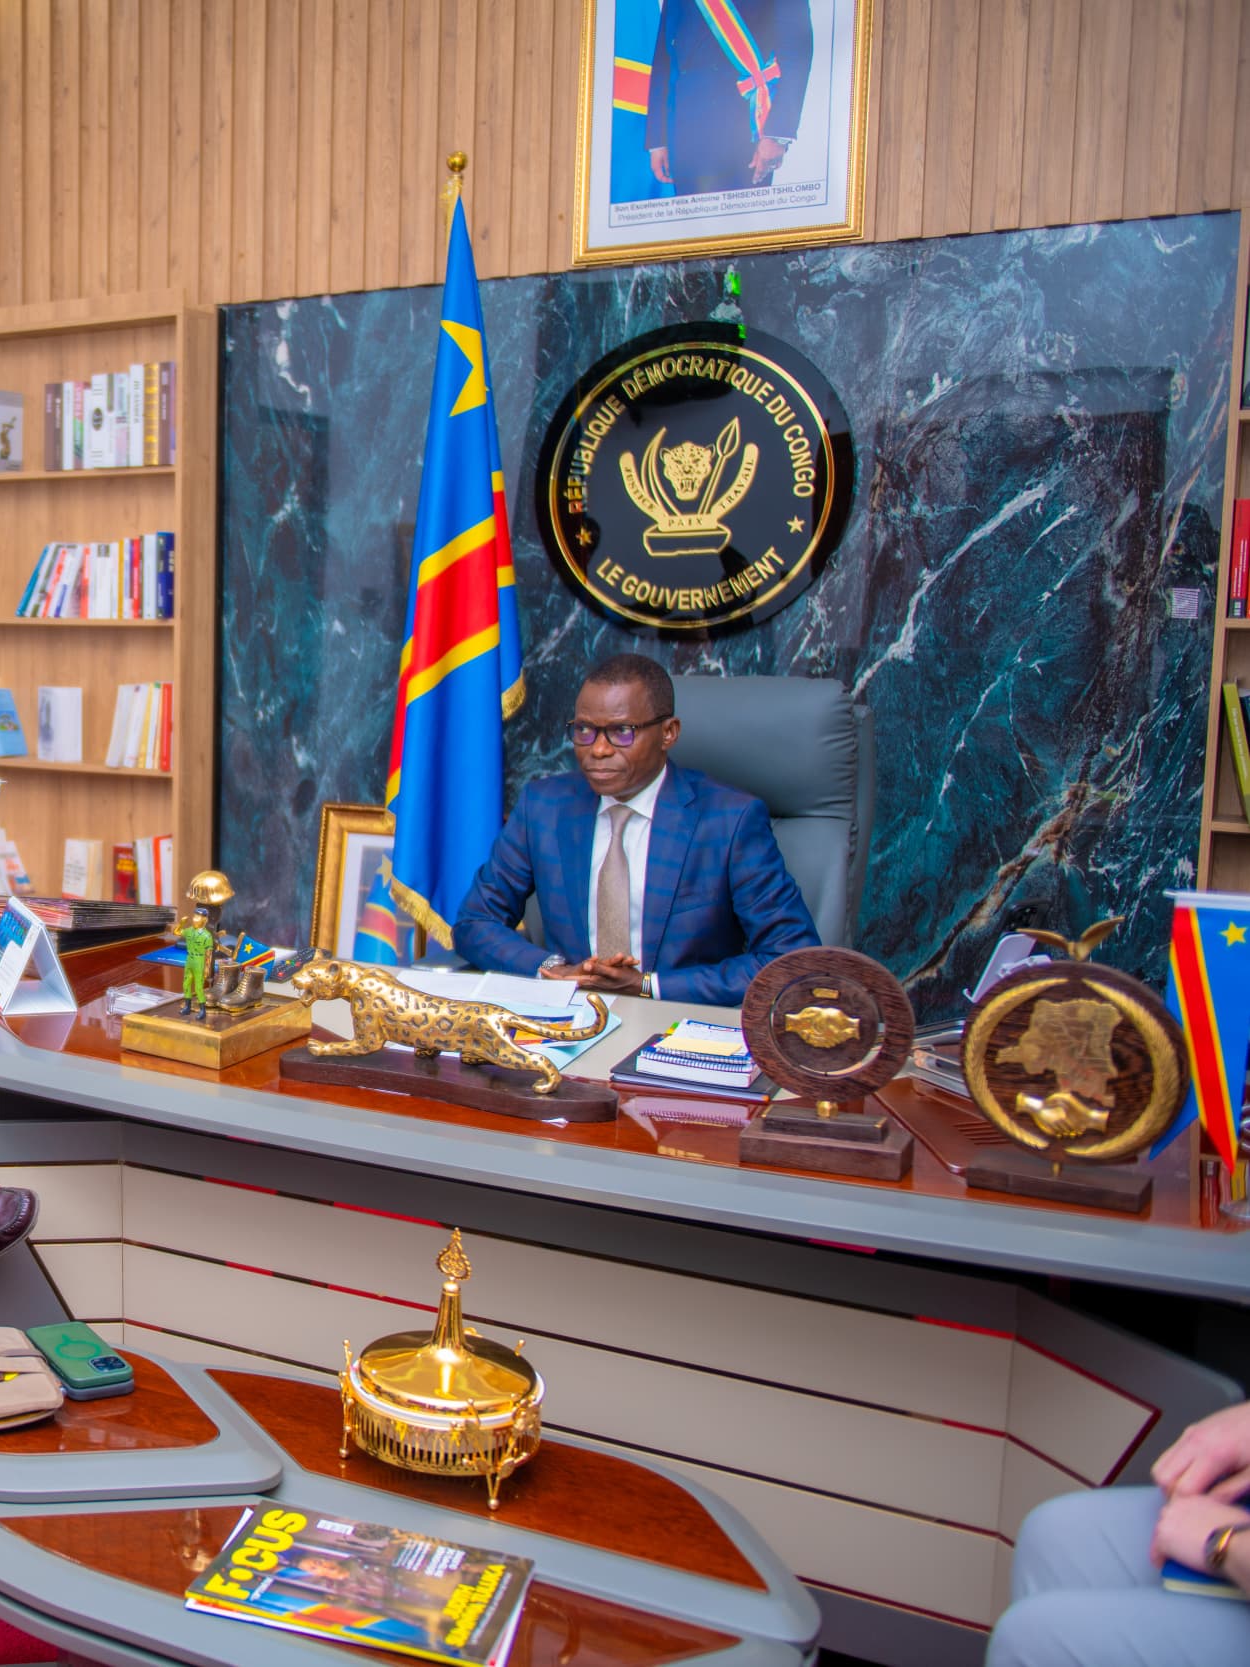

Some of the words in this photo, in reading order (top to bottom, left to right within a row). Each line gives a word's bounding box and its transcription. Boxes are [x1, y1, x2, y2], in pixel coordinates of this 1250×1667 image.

[631, 200, 669, 210] Excellence
[690, 195, 720, 203] Antoine
[722, 189, 770, 200] TSHISEKEDI
[772, 183, 821, 195] TSHILOMBO
[675, 204, 719, 216] République
[720, 199, 775, 211] Démocratique
[789, 194, 816, 205] Congo
[565, 394, 627, 514] RÉPUBLIQUE
[621, 355, 776, 404] DÉMOCRATIQUE
[764, 394, 796, 427] DU
[782, 424, 817, 498] CONGO
[624, 466, 655, 512] JUSTICE
[719, 459, 754, 509] TRAVAIL
[668, 518, 703, 527] PAIX
[596, 557, 625, 587] LE
[621, 546, 785, 611] GOUVERNEMENT
